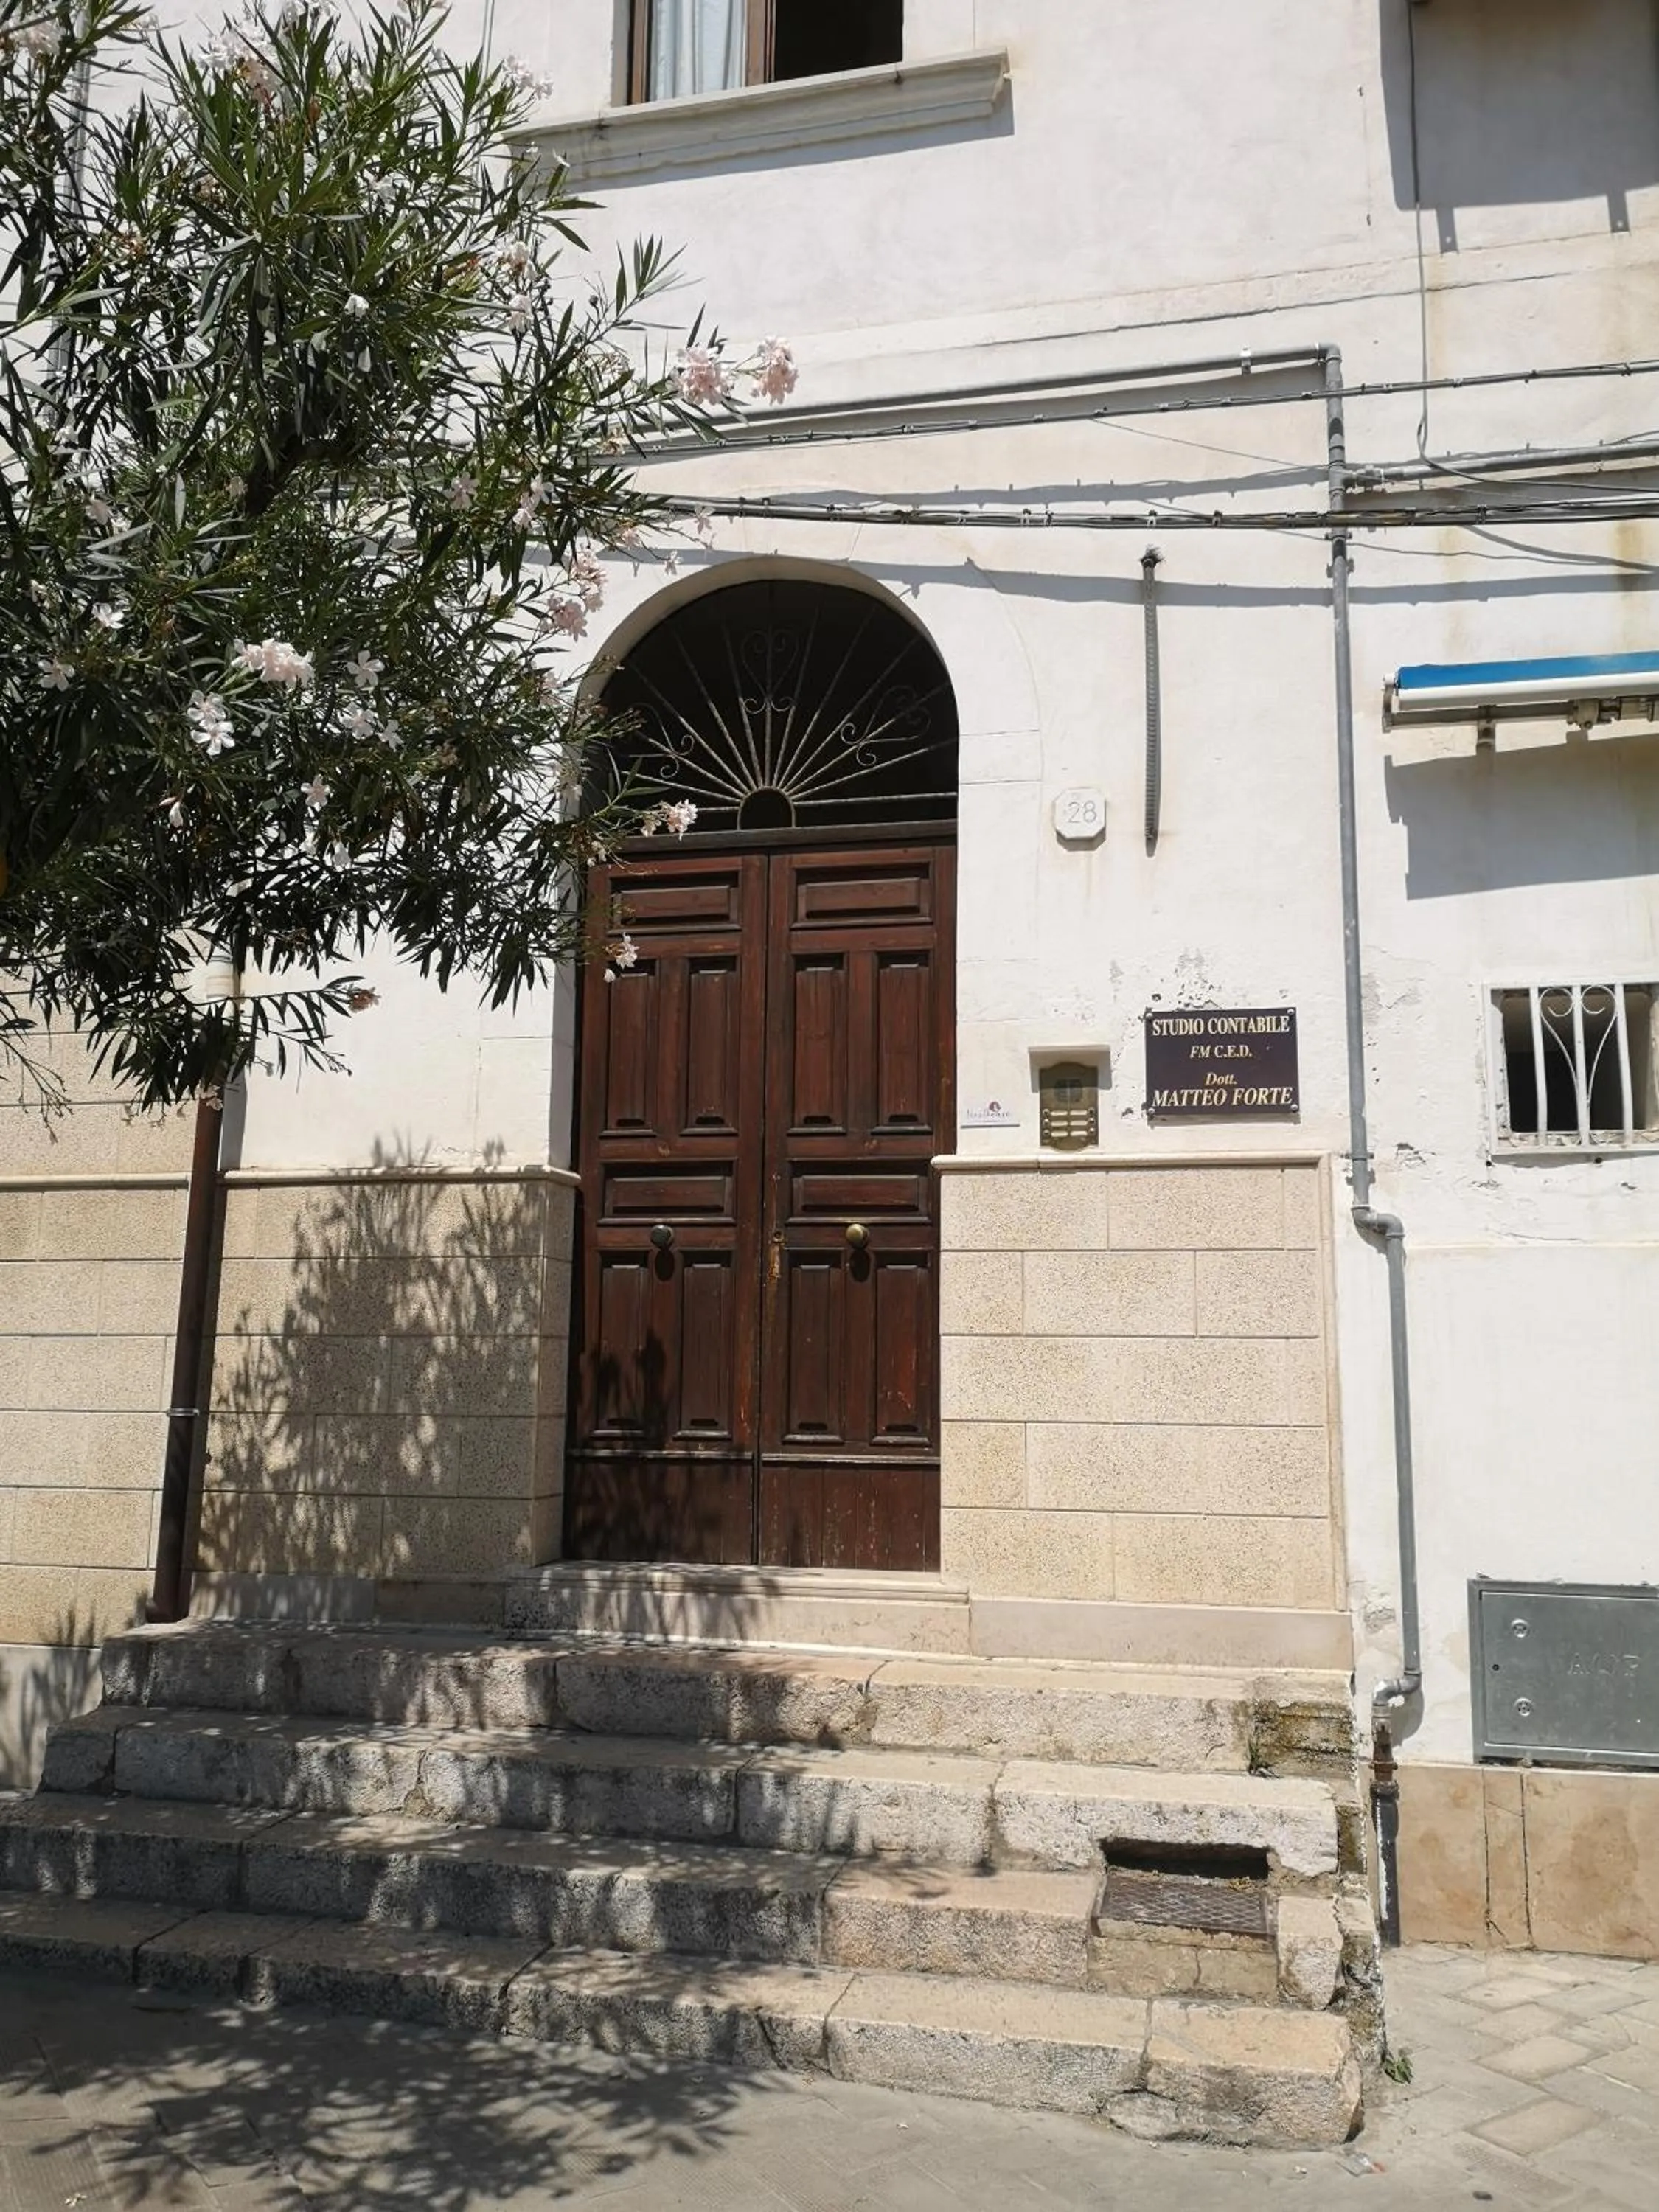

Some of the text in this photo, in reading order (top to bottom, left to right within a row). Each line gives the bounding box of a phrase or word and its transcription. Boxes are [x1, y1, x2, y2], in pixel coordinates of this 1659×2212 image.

[1068, 800, 1097, 824] 28
[1152, 1015, 1290, 1036] STUDIO CONTABILE
[1189, 1045, 1253, 1058] FM C.E.D.
[1205, 1072, 1237, 1086] Dott.
[1152, 1087, 1293, 1107] MATTEO FORTE
